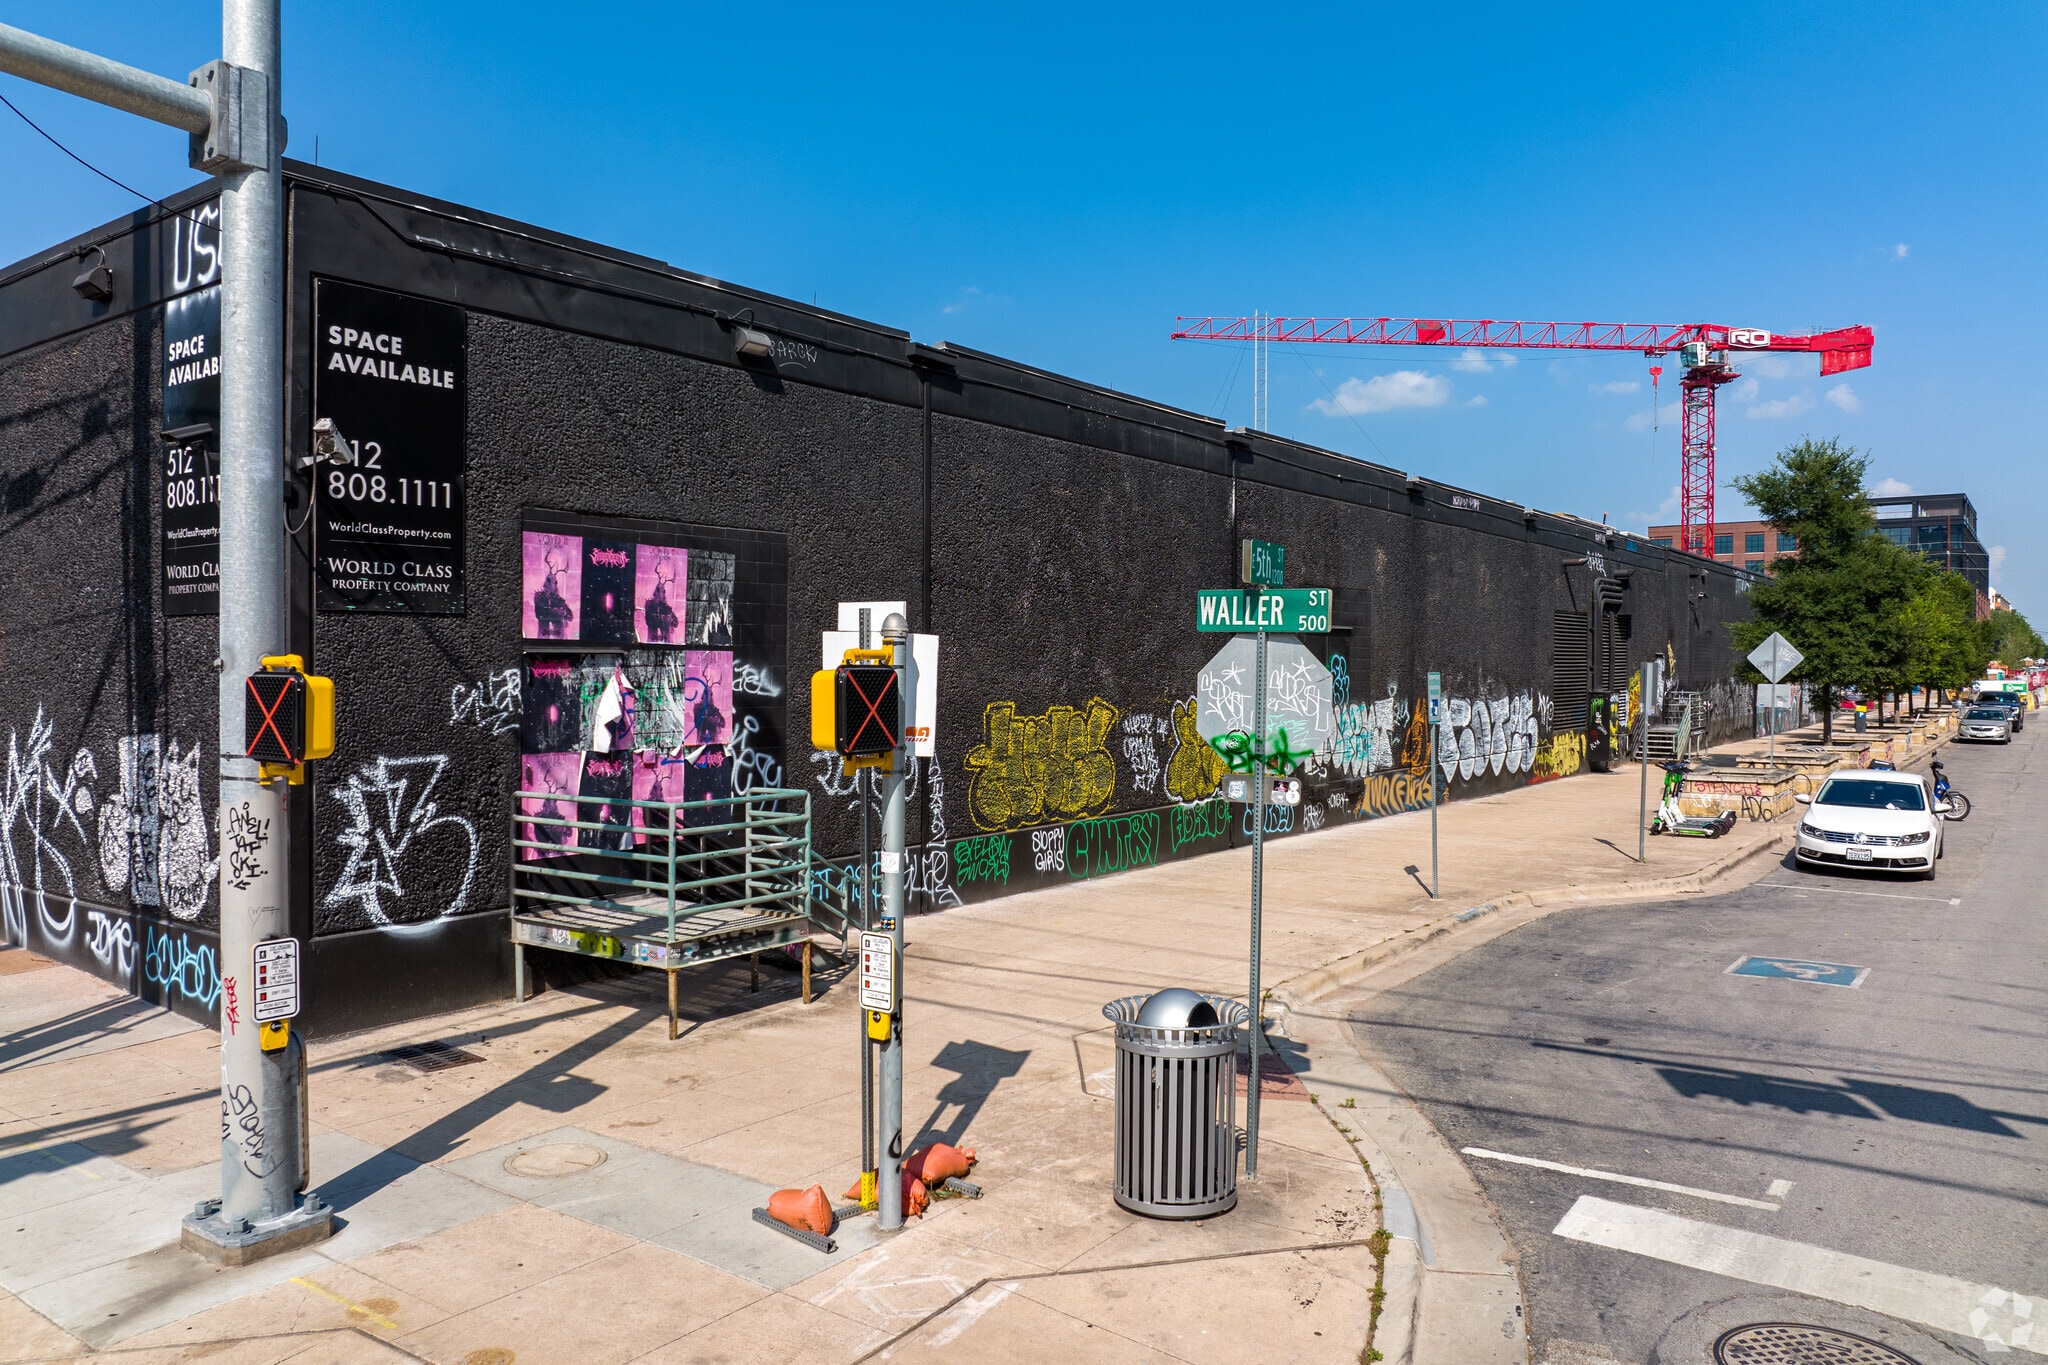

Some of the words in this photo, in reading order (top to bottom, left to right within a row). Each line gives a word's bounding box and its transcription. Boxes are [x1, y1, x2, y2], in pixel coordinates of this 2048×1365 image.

[168, 335, 204, 362] SPACE
[328, 325, 402, 356] SPACE
[1730, 332, 1769, 345] RO
[328, 352, 454, 389] AVAILABLE
[167, 446, 193, 476] 512
[328, 471, 451, 508] 808.1111
[329, 521, 452, 540] WorldClassProperty.com
[167, 565, 200, 579] WORLD
[328, 557, 396, 575] WORLD
[402, 562, 453, 578] CLASS
[1256, 547, 1272, 579] 5th
[1278, 547, 1284, 563] ST
[168, 584, 197, 595] PROPERTY
[332, 579, 390, 590] PROPERTY
[394, 582, 450, 593] COMPANY
[1200, 595, 1284, 626] WALLER
[1308, 590, 1328, 607] ST
[1298, 614, 1328, 631] 500
